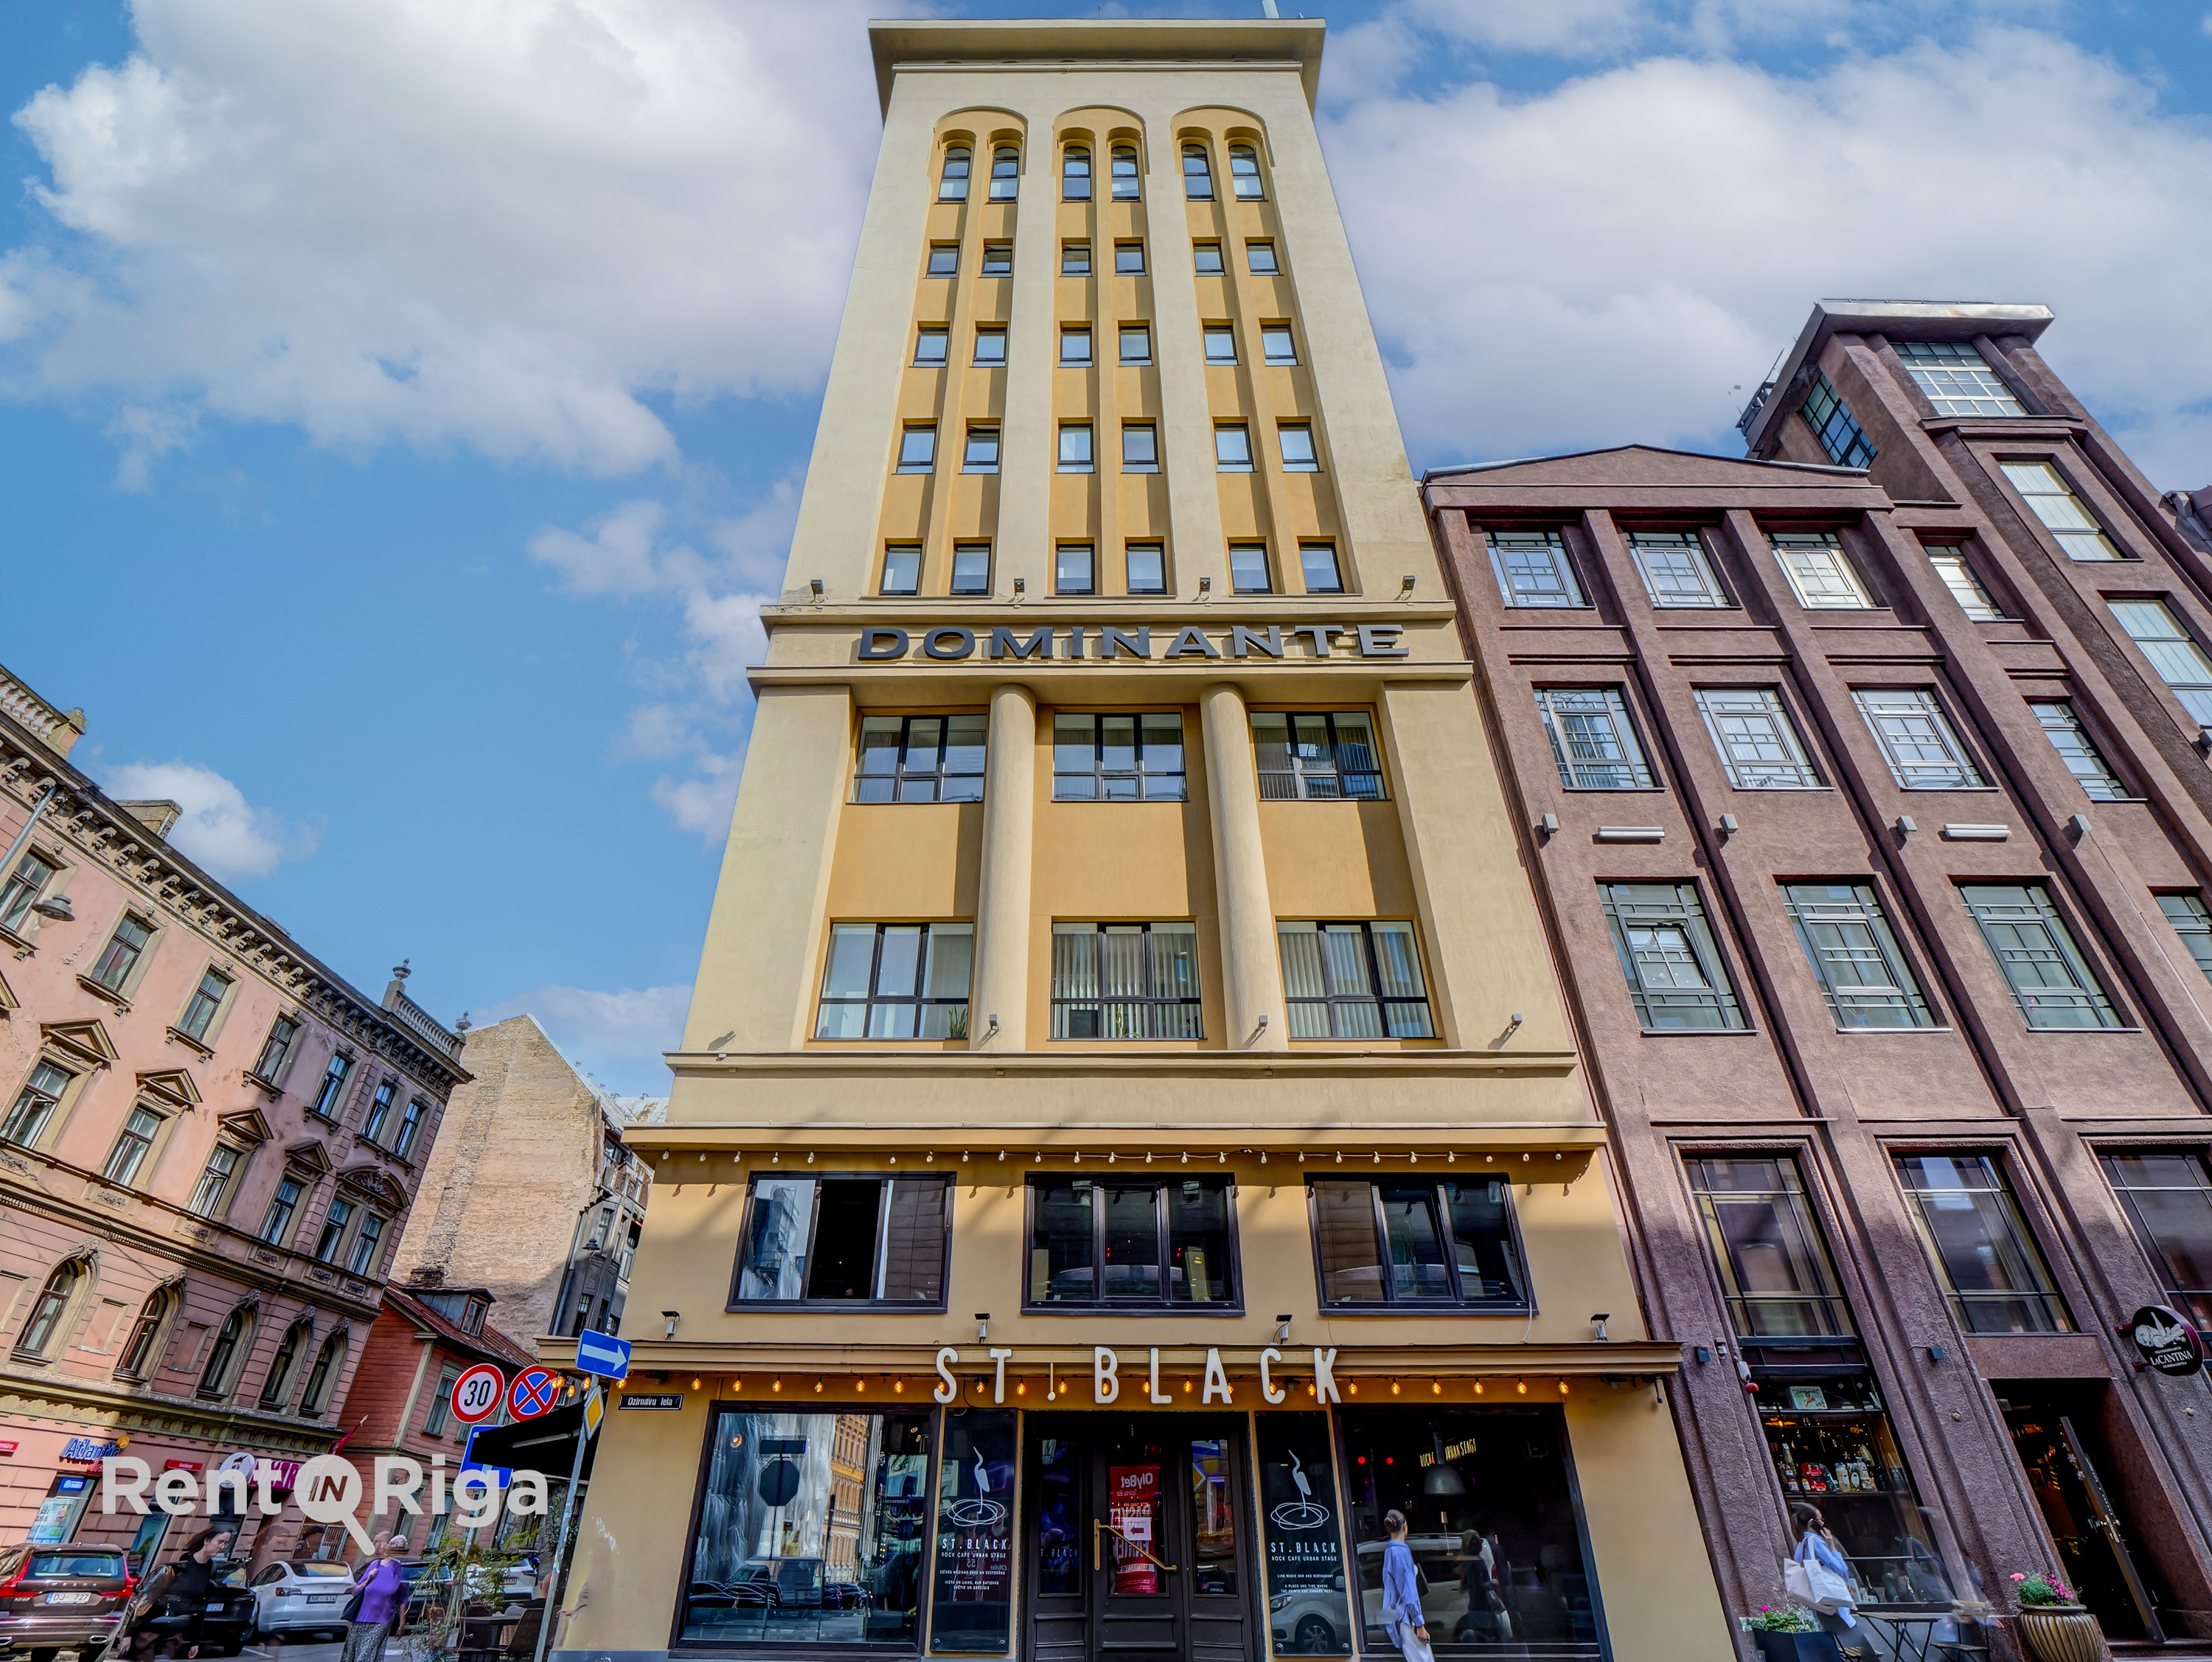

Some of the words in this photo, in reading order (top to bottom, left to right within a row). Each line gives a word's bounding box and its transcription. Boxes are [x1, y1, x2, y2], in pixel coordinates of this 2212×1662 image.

[858, 625, 1411, 661] DOMINANTE
[933, 1346, 1056, 1404] ST.
[1095, 1346, 1342, 1405] BLACK
[464, 1380, 491, 1407] 30
[627, 1397, 657, 1405] Dzirnavu
[62, 1438, 120, 1461] Atlantic
[942, 1538, 962, 1549] ST.
[967, 1538, 1007, 1550] BLACK
[1270, 1542, 1292, 1553] ST.
[1295, 1542, 1336, 1553] BLACK
